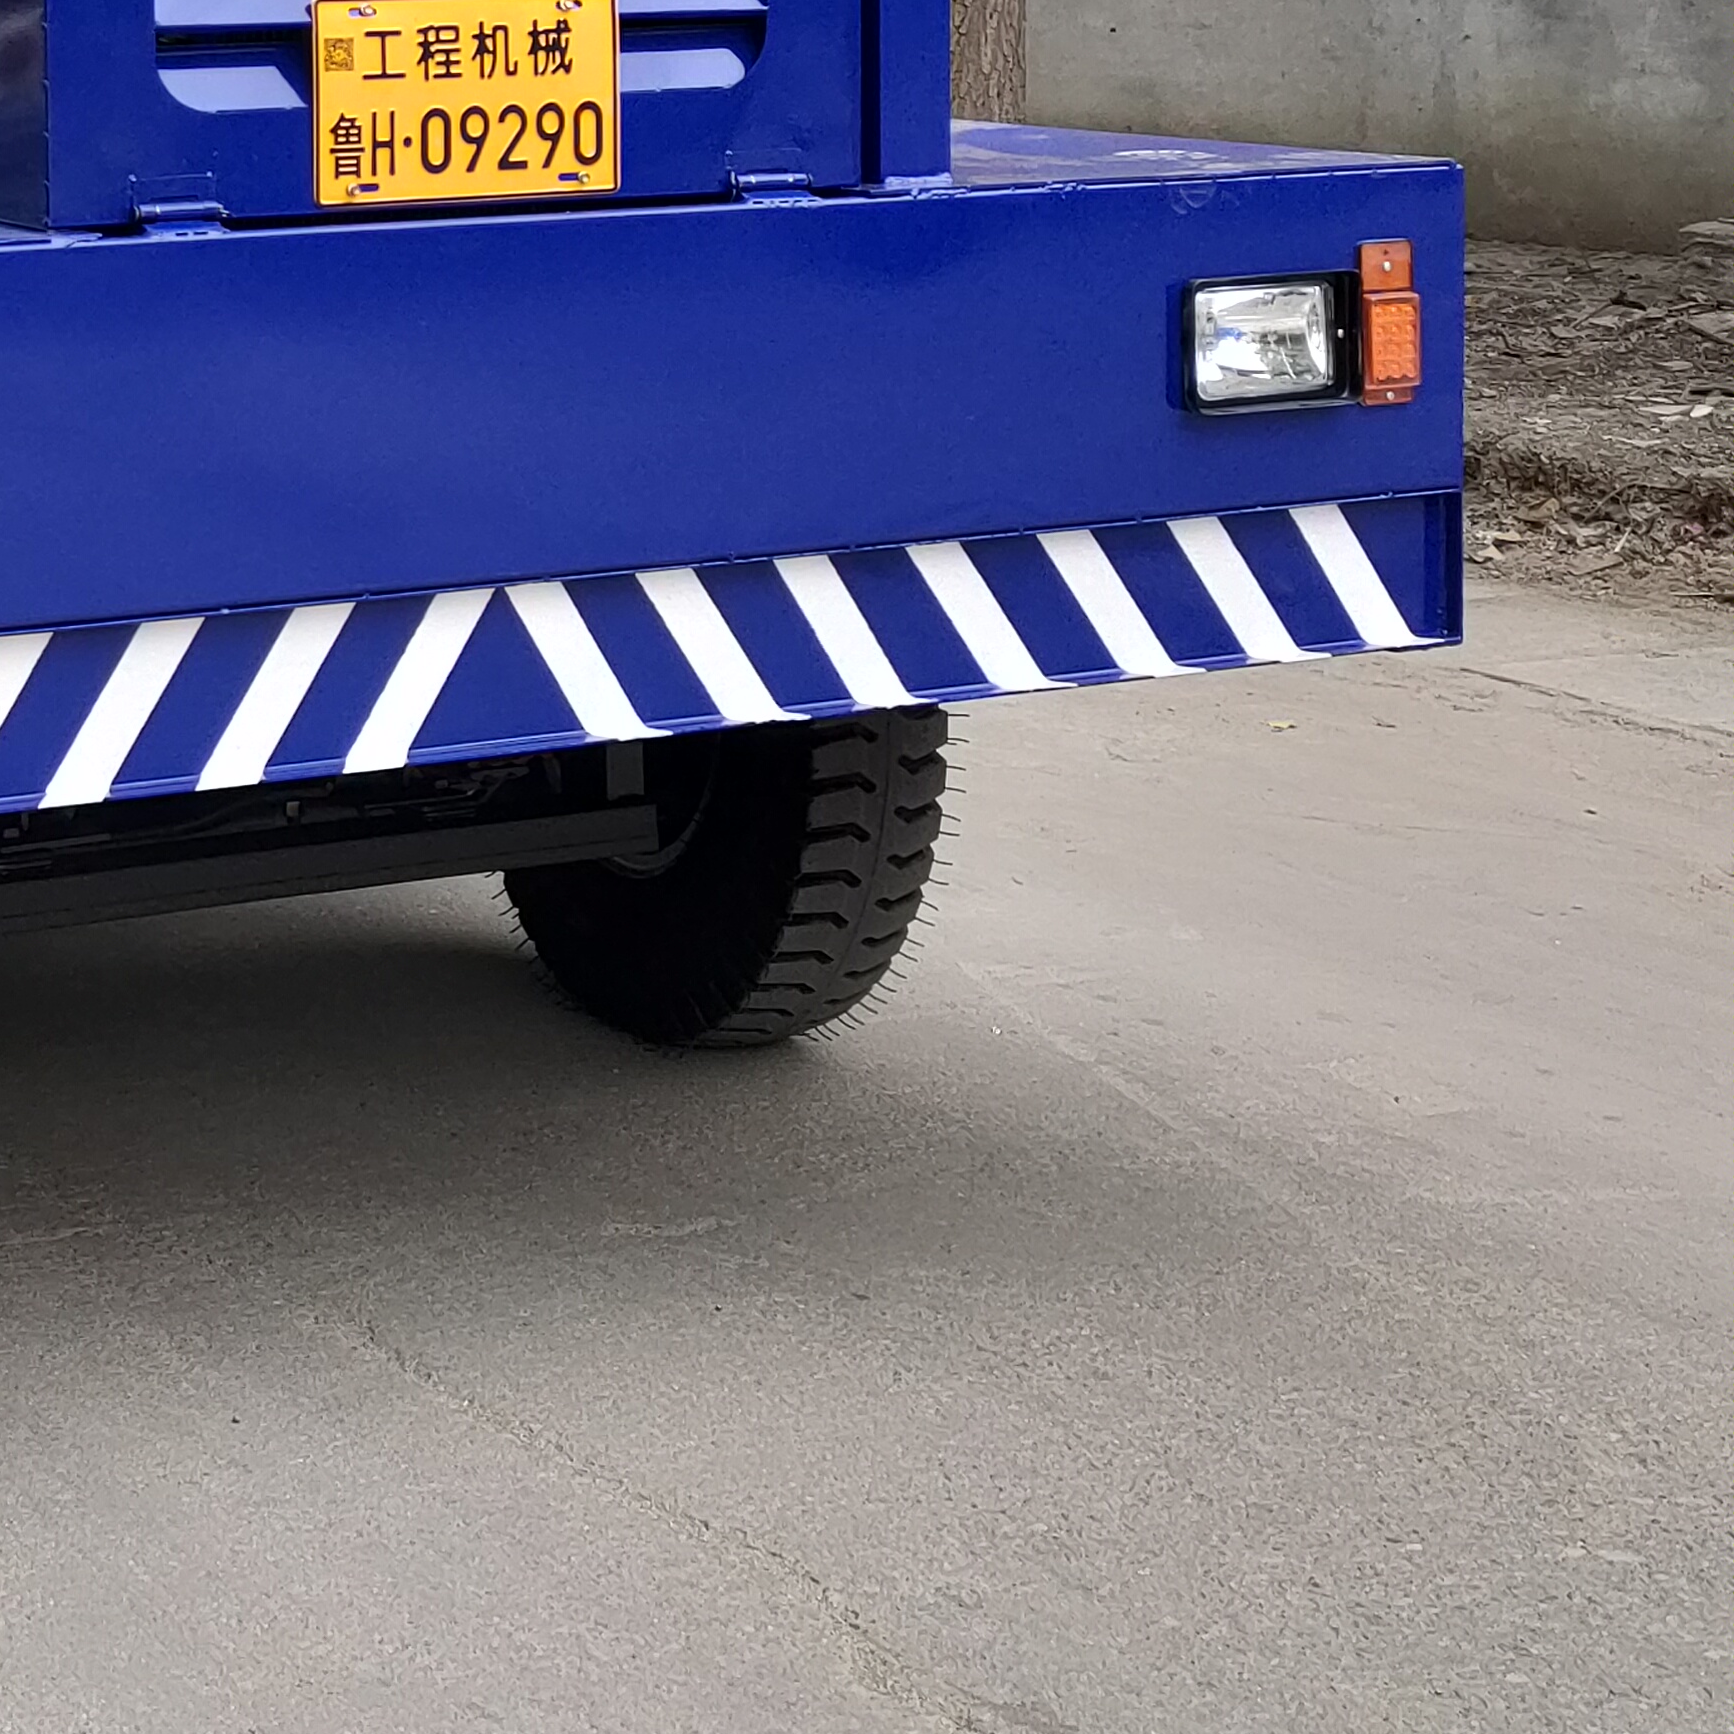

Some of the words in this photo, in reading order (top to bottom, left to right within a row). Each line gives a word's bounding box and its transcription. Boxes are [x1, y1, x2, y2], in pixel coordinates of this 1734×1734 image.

[362, 18, 573, 81] 工程机械
[329, 100, 603, 179] 鲁H·09290
